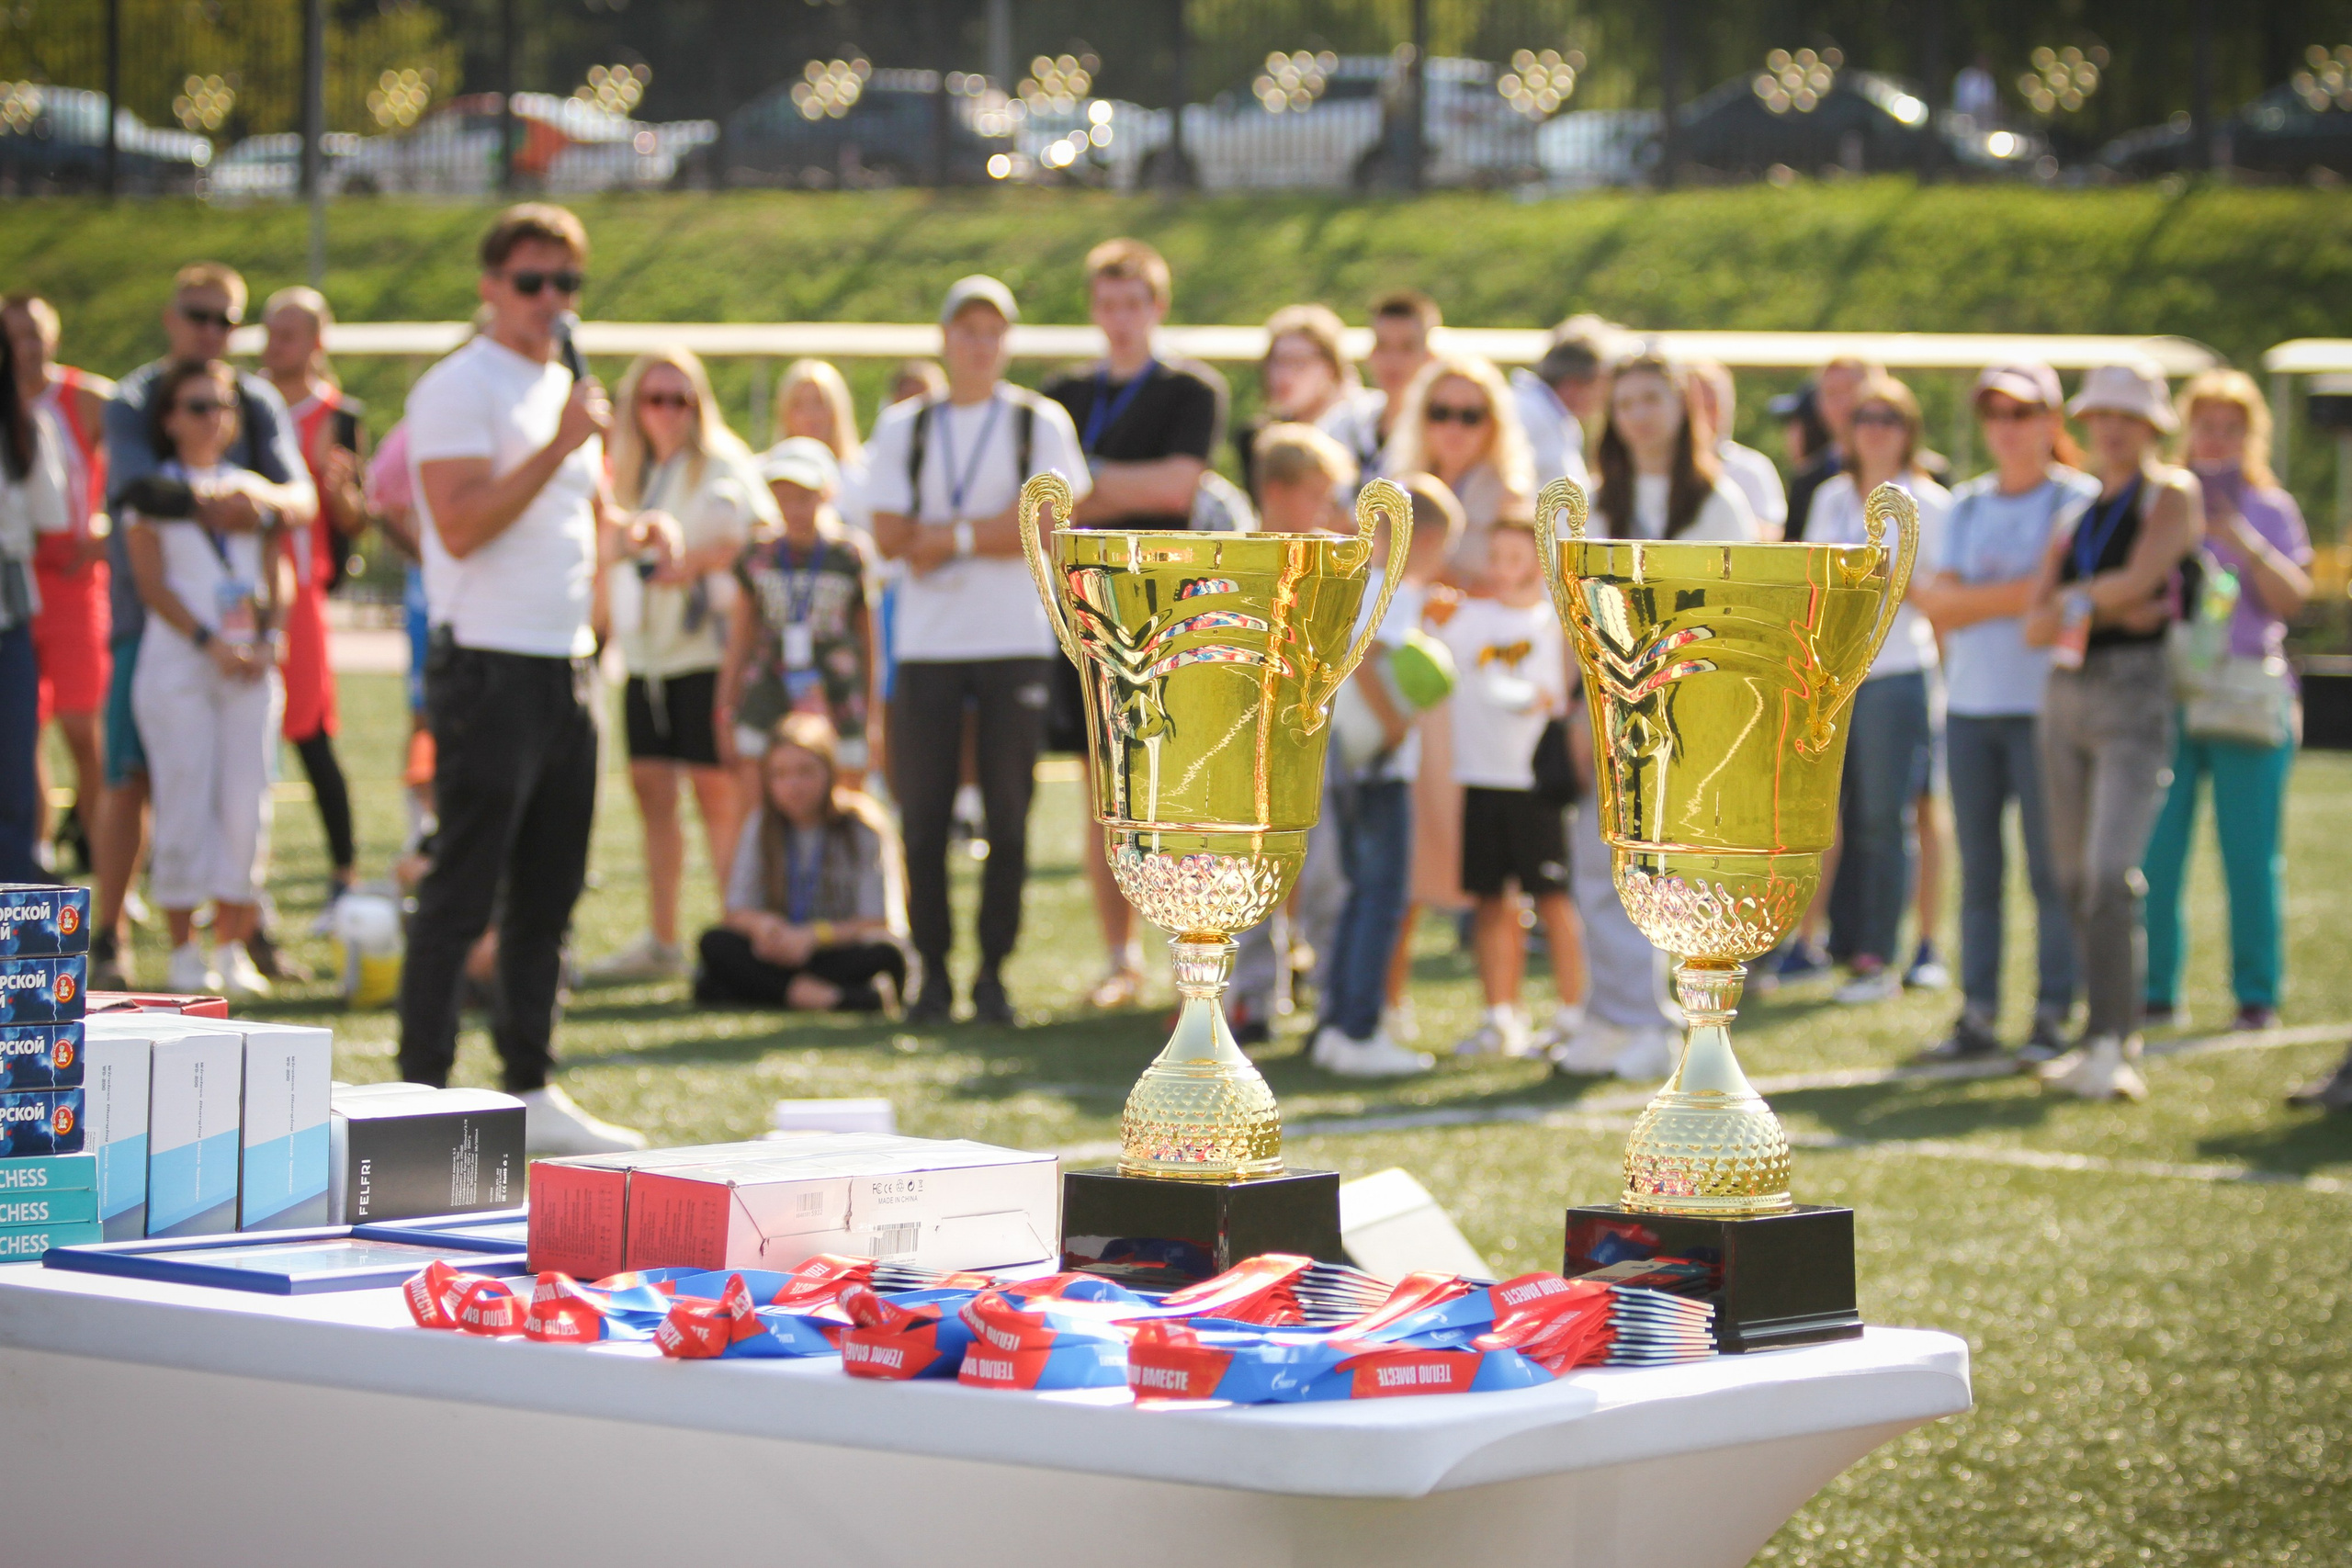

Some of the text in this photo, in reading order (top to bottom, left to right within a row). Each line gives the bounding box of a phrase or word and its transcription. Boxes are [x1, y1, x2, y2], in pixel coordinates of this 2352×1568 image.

[0, 1168, 47, 1188] CHESS
[359, 1160, 371, 1215] FELFRI
[901, 1194, 918, 1202] CHINA
[0, 1202, 49, 1222] CHESS
[0, 1234, 49, 1255] CHESS
[1500, 1278, 1570, 1306] ТЕПЛО ВМЕСТЕ
[870, 1344, 904, 1369] ТЕПЛО
[979, 1359, 1015, 1381] ТЕПЛО
[1142, 1365, 1189, 1391] ВМЕСТЕ
[1377, 1365, 1452, 1387] ТЕПЛО ВМЕСТЕ
